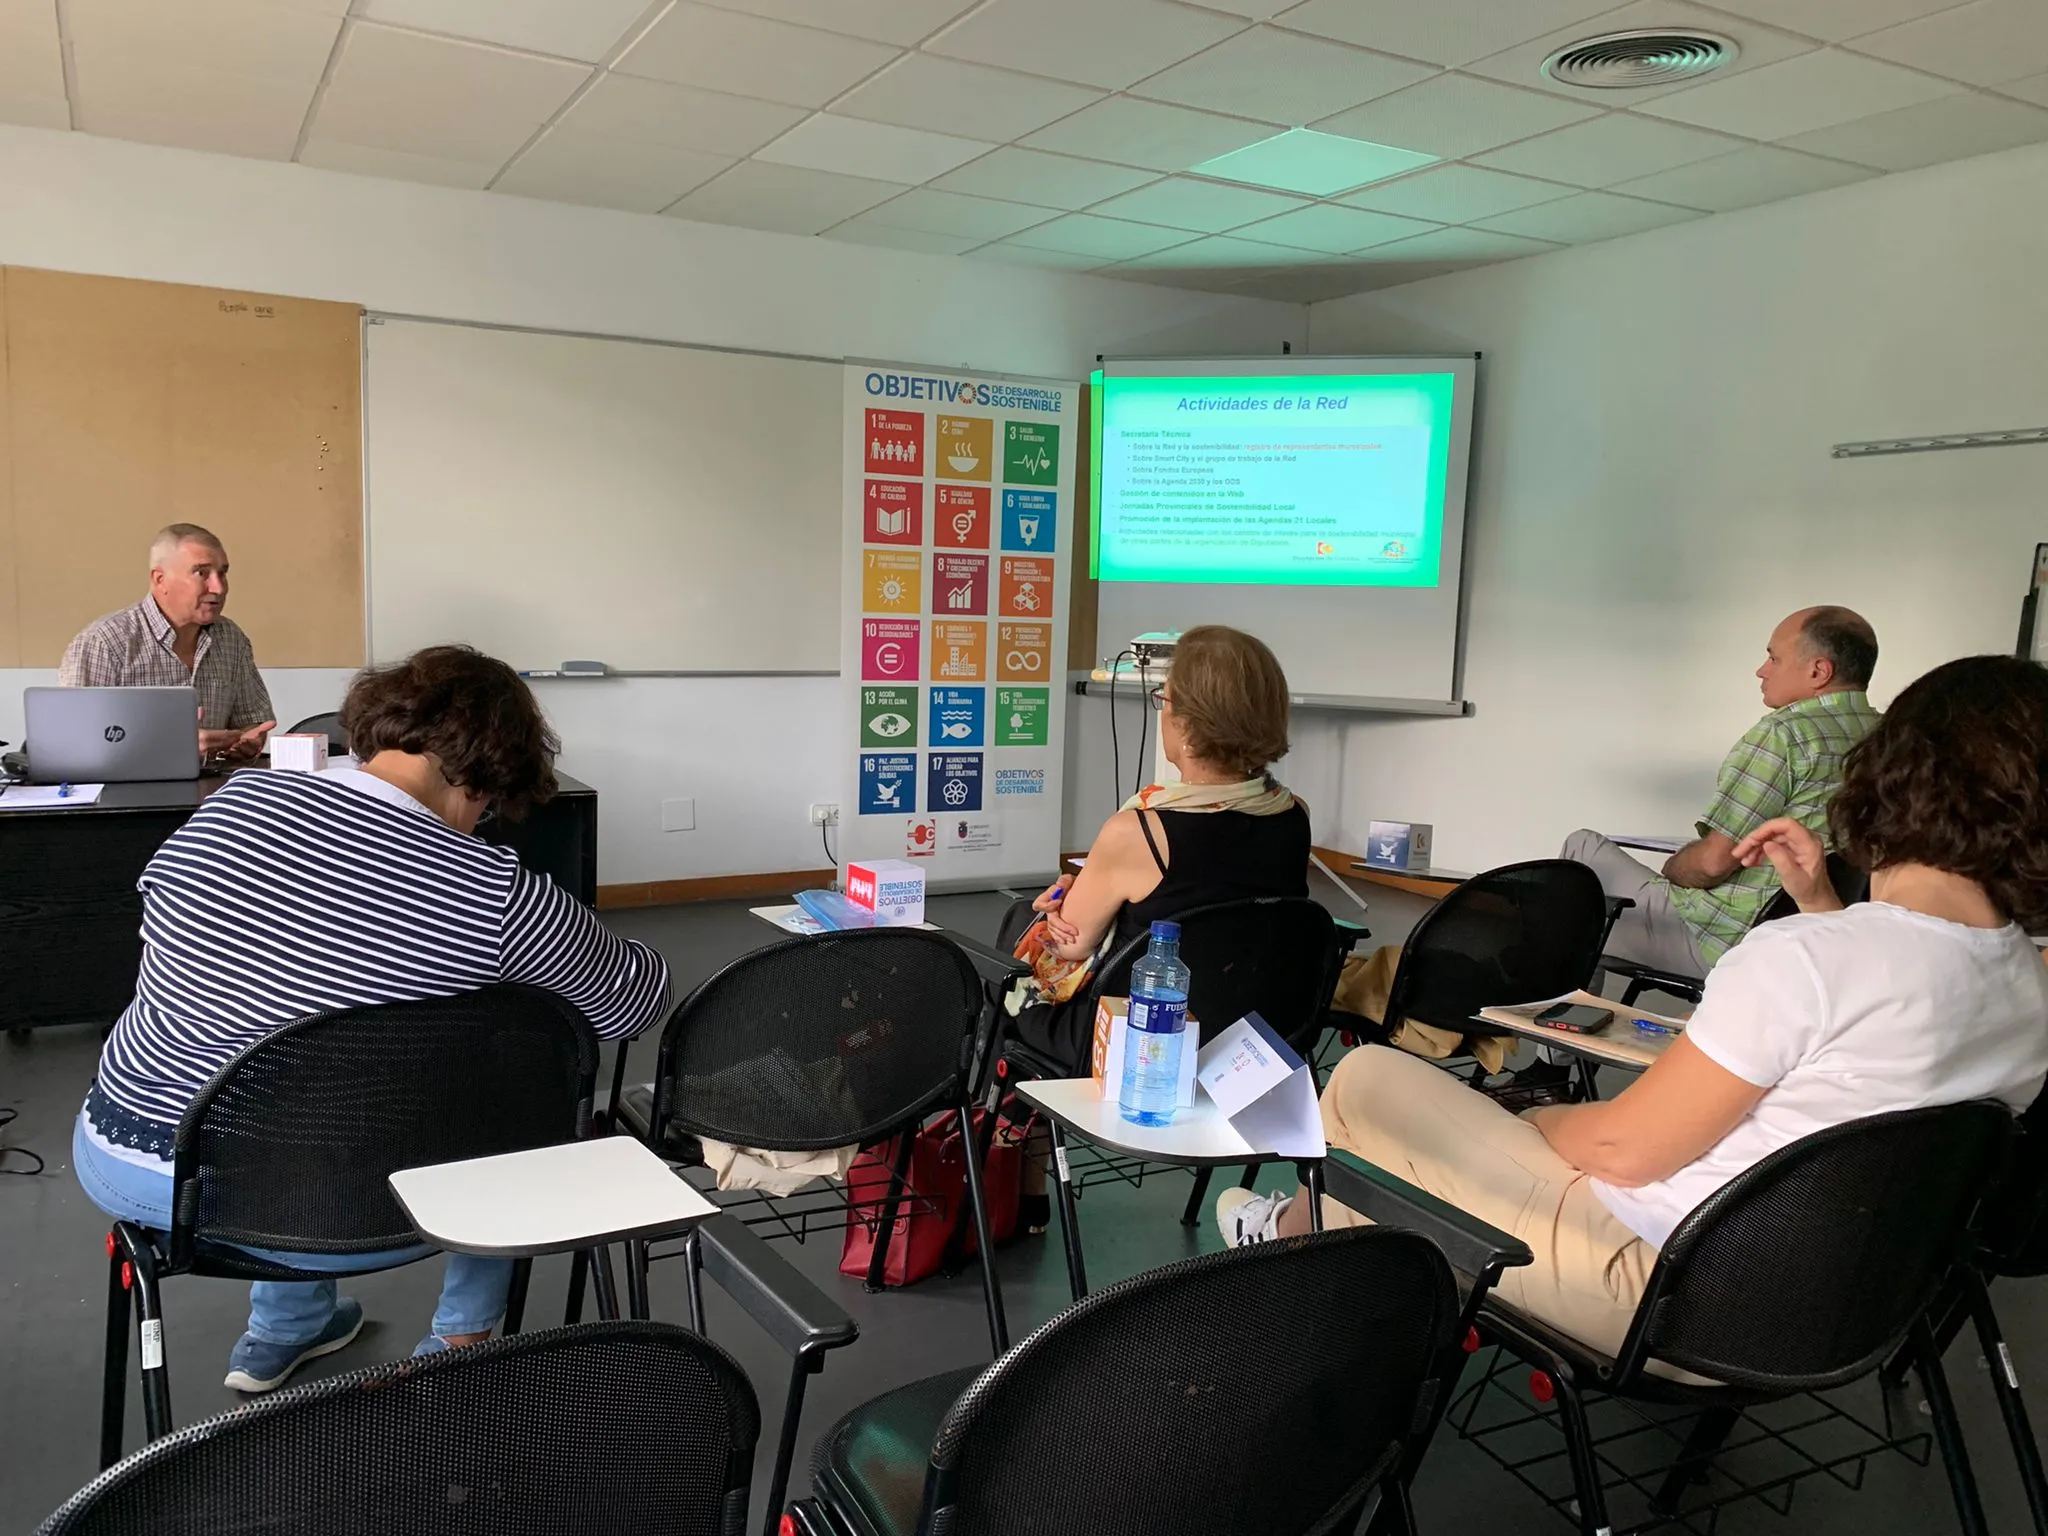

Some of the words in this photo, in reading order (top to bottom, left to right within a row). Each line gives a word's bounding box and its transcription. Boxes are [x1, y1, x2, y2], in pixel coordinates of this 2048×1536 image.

[865, 373, 991, 406] OBJETIVOS
[991, 385, 1004, 395] DE
[1005, 386, 1062, 401] DESARROLLO
[991, 395, 1062, 413] SOSTENIBLE
[1177, 396, 1268, 411] Actividades
[1273, 396, 1293, 410] de
[1297, 396, 1311, 410] la
[1316, 396, 1349, 410] Red
[871, 413, 877, 428] 1
[941, 420, 949, 434] 2
[1009, 426, 1016, 440] 3
[869, 484, 877, 499] 4
[940, 489, 947, 504] 5
[1007, 494, 1014, 508] 6
[867, 553, 875, 569] 7
[937, 558, 945, 572] 8
[1004, 560, 1012, 575] 9
[865, 623, 877, 637] 10
[935, 625, 944, 639] 11
[1001, 626, 1012, 640] 12
[864, 691, 876, 705] 13
[933, 691, 944, 705] 14
[1000, 691, 1010, 705] 15
[106, 726, 123, 742] hp
[864, 758, 875, 773] 16
[932, 756, 943, 771] 17
[996, 769, 1044, 780] OBJETIVOS
[996, 785, 1044, 795] SOSTENIBLE
[879, 880, 923, 891] SOSTENIBLE
[878, 895, 923, 907] OBJETIVOS
